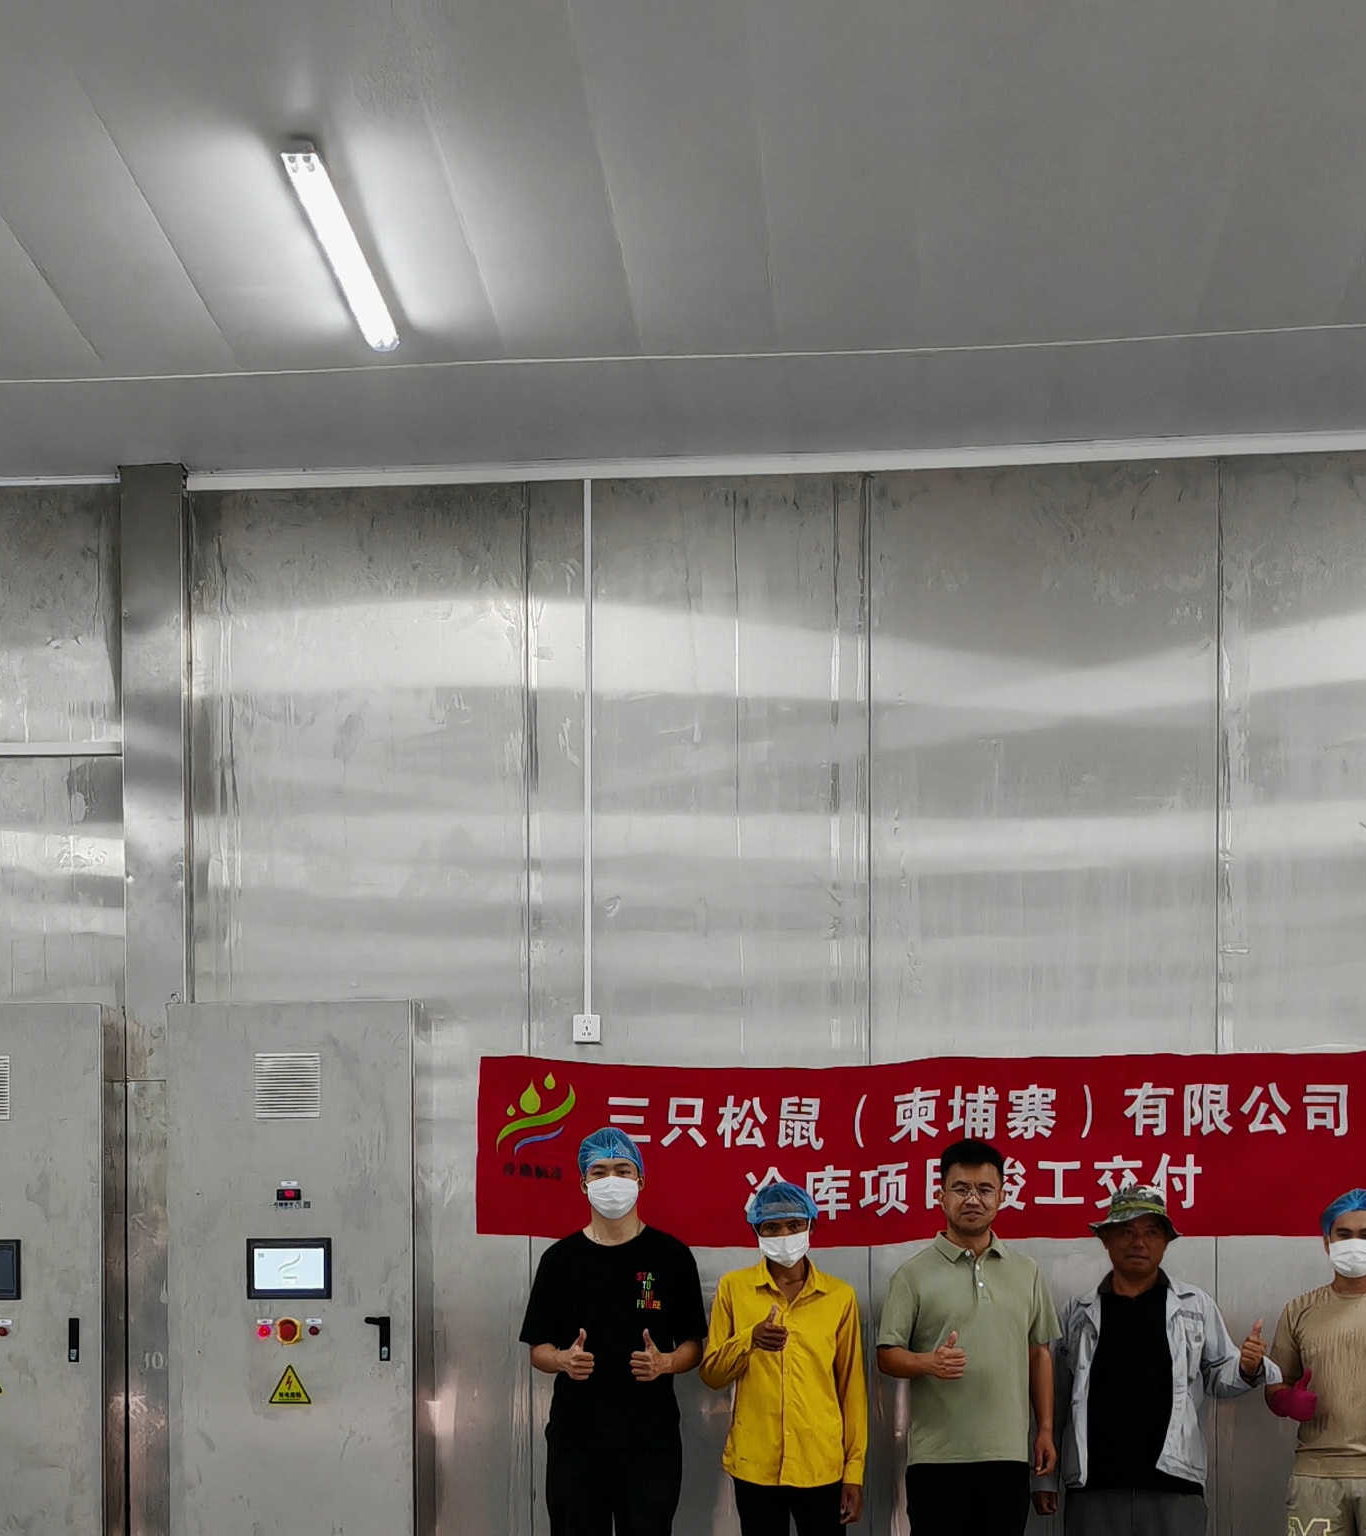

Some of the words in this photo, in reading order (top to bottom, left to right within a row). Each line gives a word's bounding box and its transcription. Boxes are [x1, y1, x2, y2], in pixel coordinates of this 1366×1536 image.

[608, 1082, 1348, 1150] 三只松鼠（柬埔寨）有限公司
